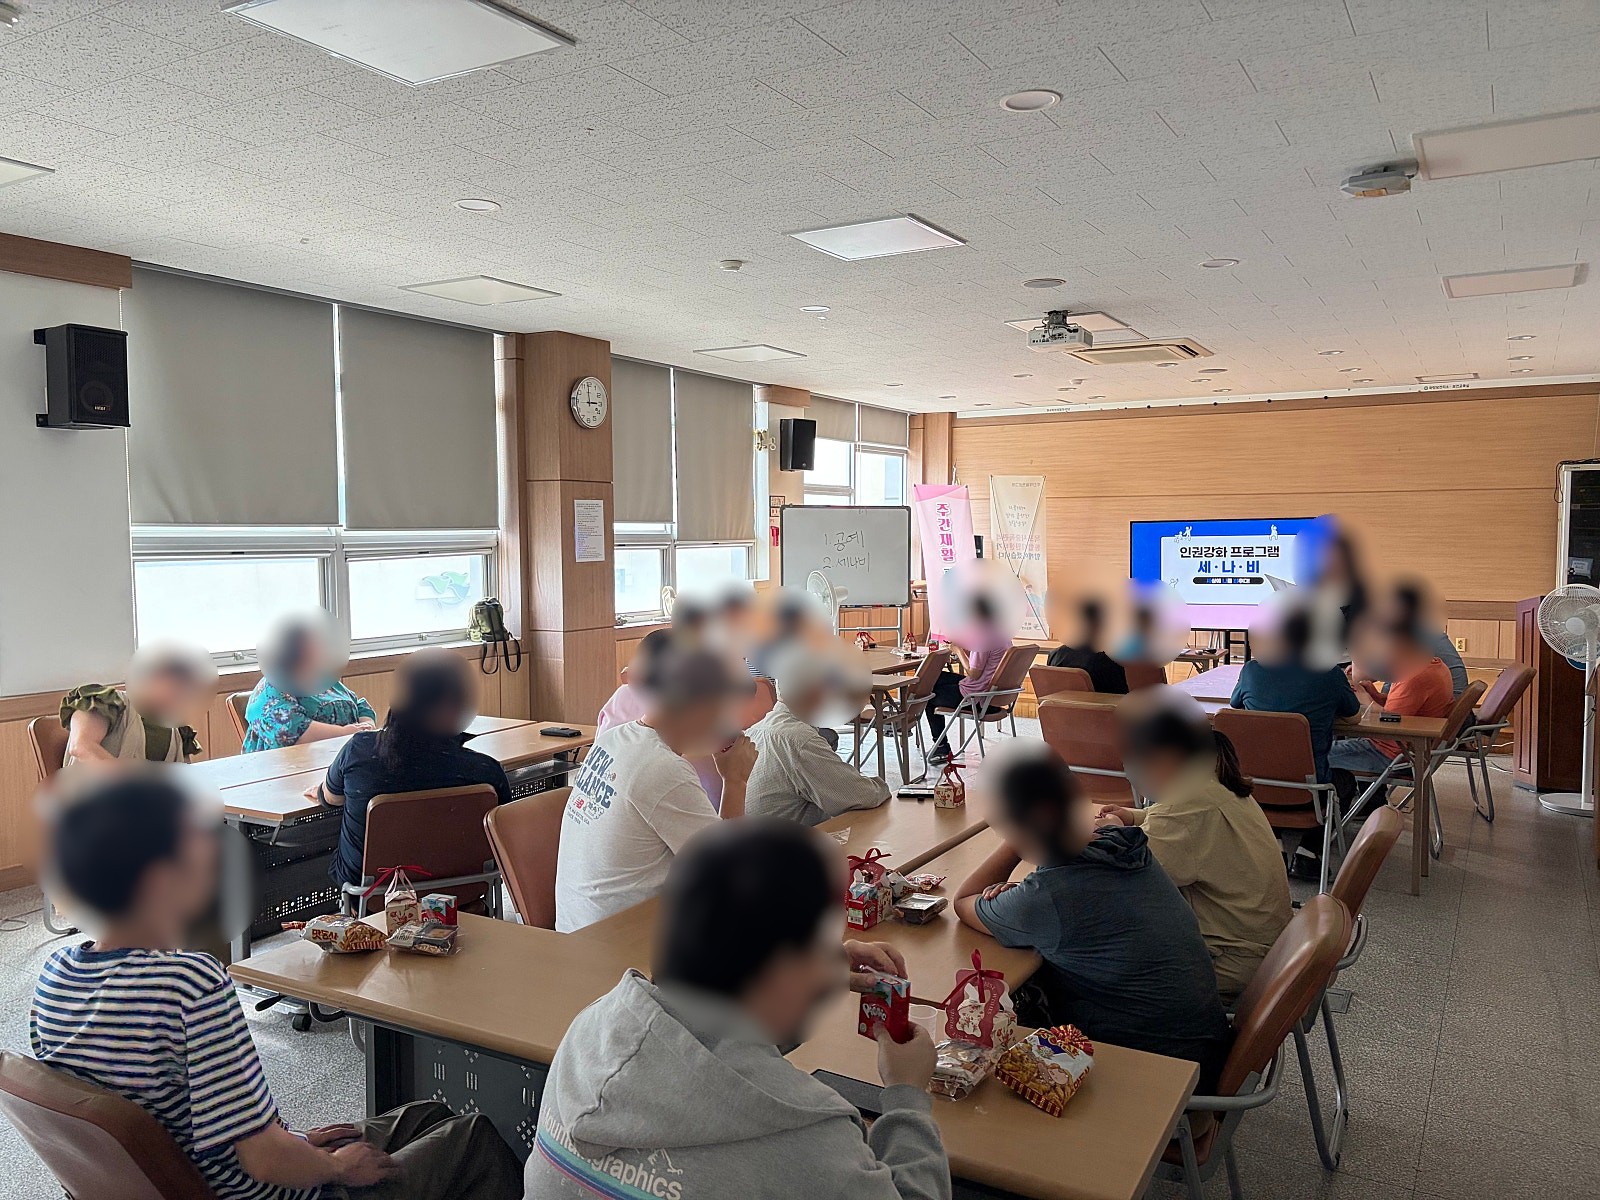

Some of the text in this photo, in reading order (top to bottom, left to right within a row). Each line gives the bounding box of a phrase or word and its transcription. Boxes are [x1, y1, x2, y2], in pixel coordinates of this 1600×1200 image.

[936, 503, 956, 562] 주간재활
[1180, 545, 1280, 558] 인권강화 프로그램
[585, 745, 614, 777] NEW
[575, 766, 615, 809] LANCE
[311, 928, 339, 943] 맛동산
